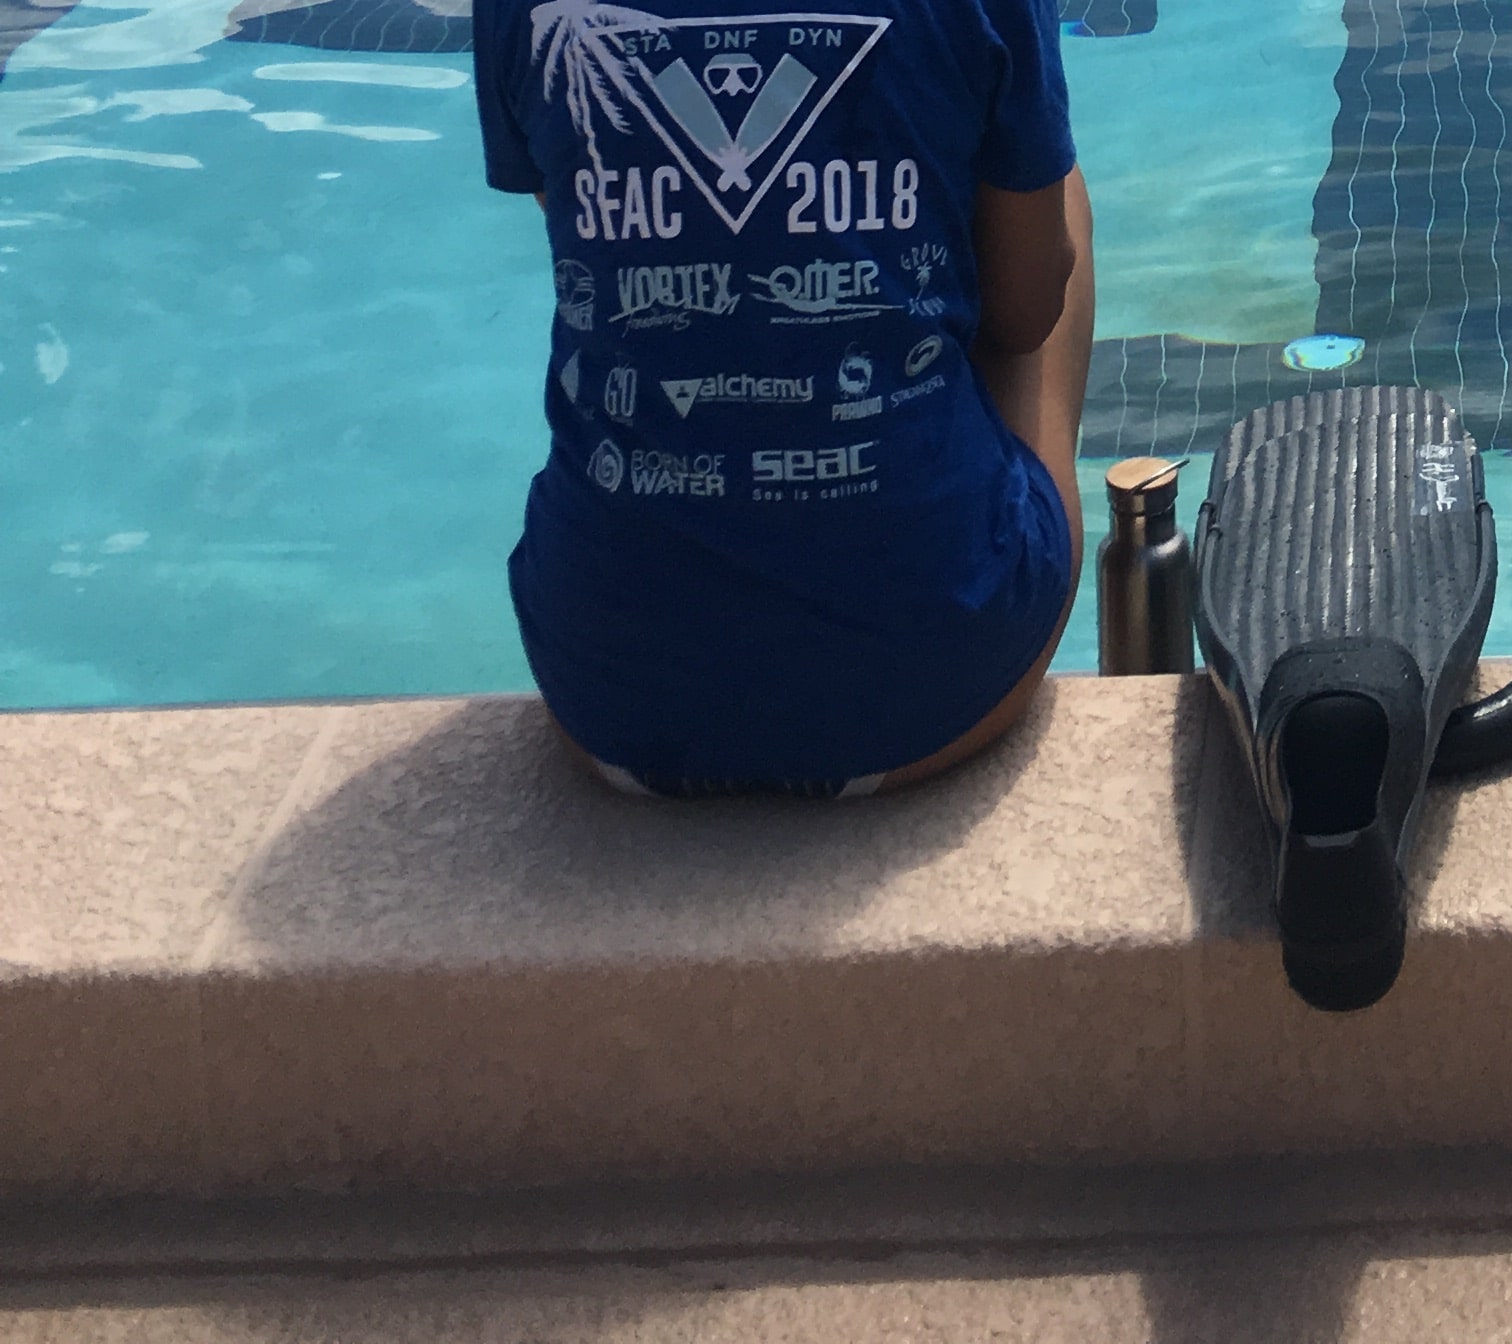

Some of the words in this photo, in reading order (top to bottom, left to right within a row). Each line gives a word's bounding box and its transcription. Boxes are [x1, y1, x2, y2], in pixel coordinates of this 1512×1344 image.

[624, 28, 672, 56] STA
[704, 29, 758, 50] DNF
[788, 27, 843, 48] DYN
[575, 165, 682, 241] SFAC
[787, 158, 919, 234] 2018
[616, 263, 732, 315] VORTEX
[700, 373, 815, 403] alchemy
[631, 449, 688, 473] BORN
[693, 454, 726, 475] OF
[752, 440, 880, 481] seac
[630, 470, 725, 497] WATER
